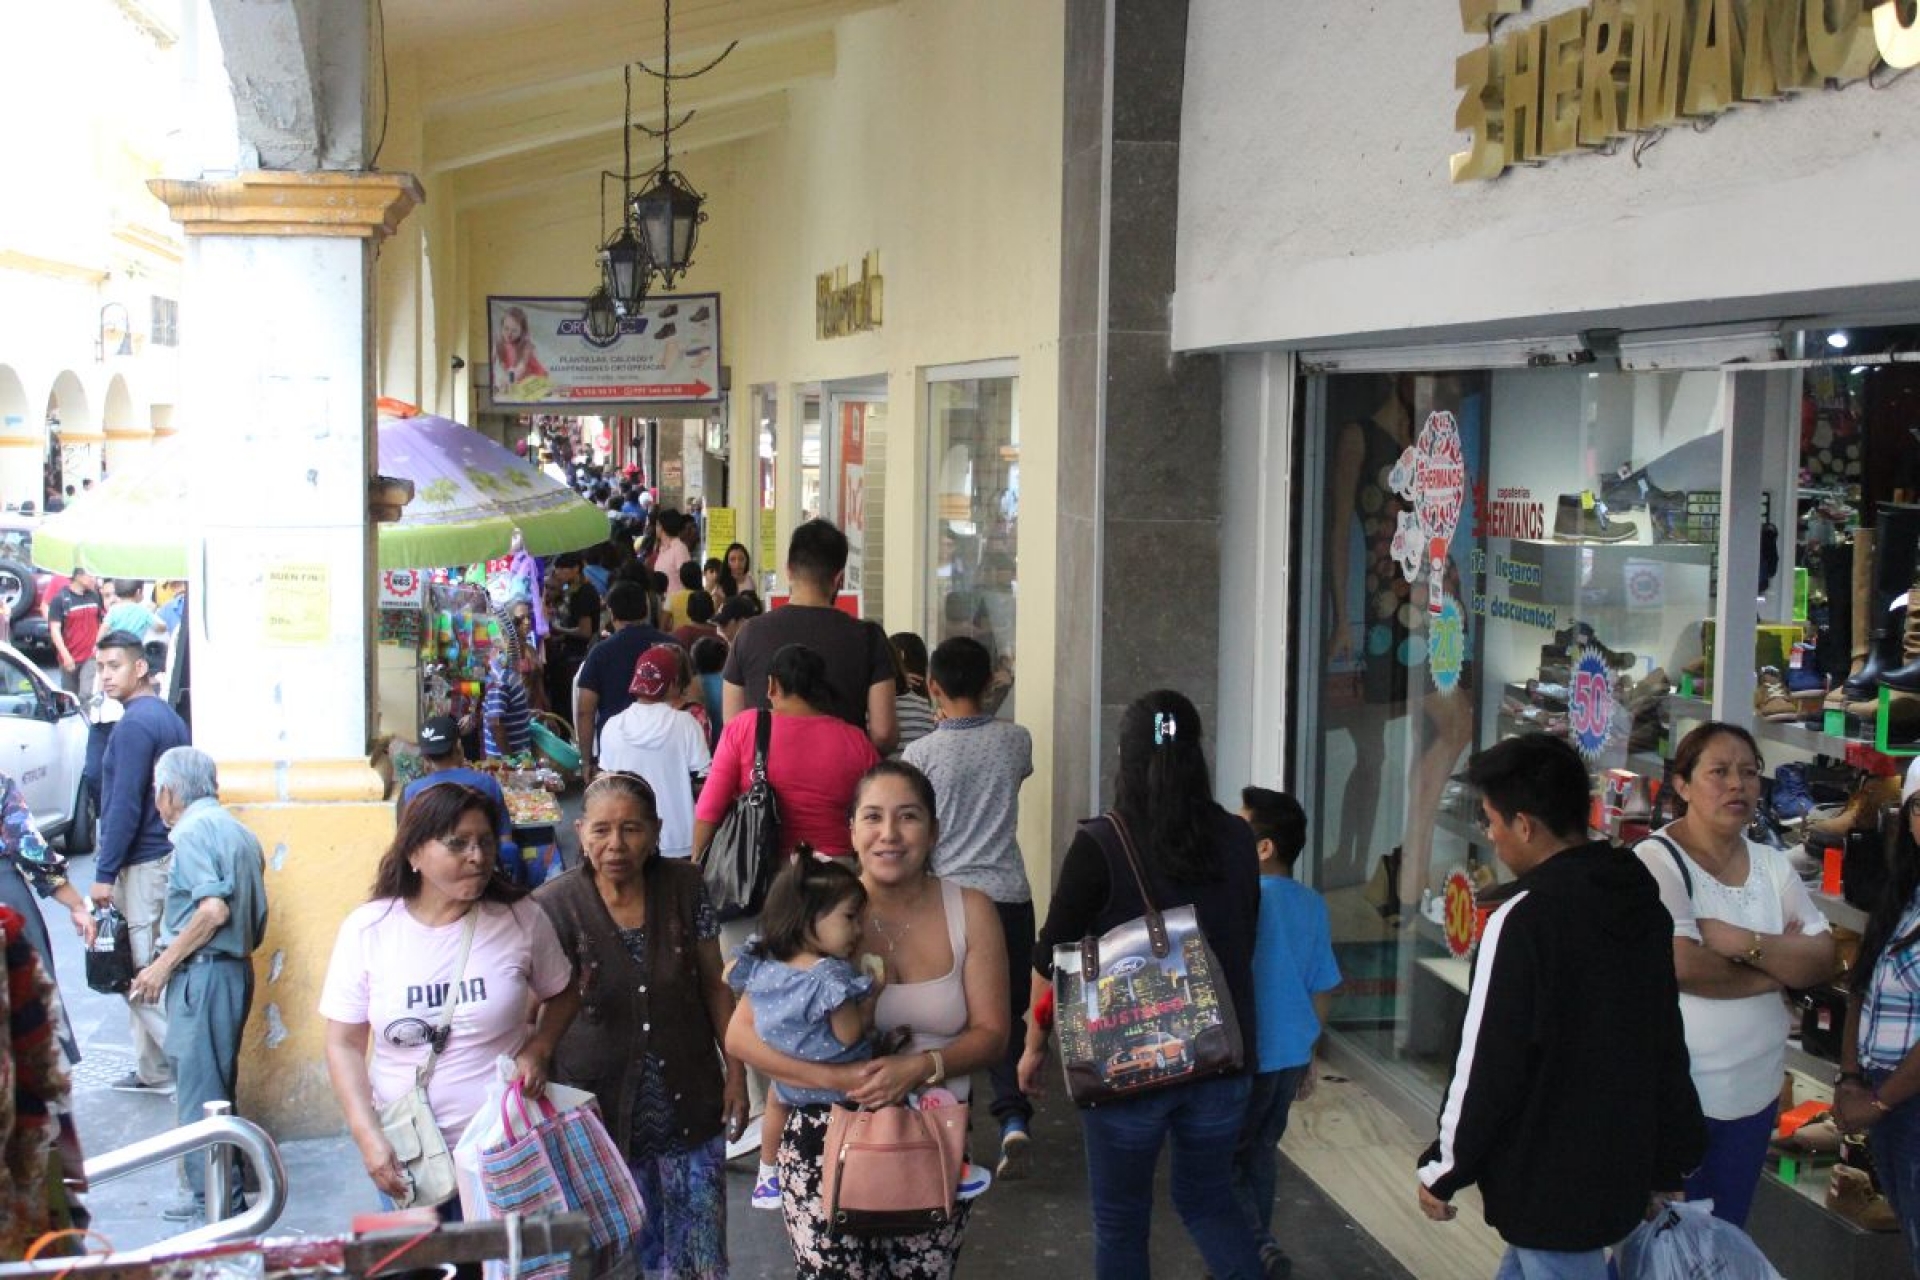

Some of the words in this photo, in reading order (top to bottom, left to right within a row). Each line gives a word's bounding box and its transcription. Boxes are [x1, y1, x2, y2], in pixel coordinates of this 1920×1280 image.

[1487, 501, 1545, 539] HERMANOS
[1495, 555, 1542, 585] llegaron
[1491, 595, 1556, 630] descuentos!
[407, 977, 487, 1009] PUMA
